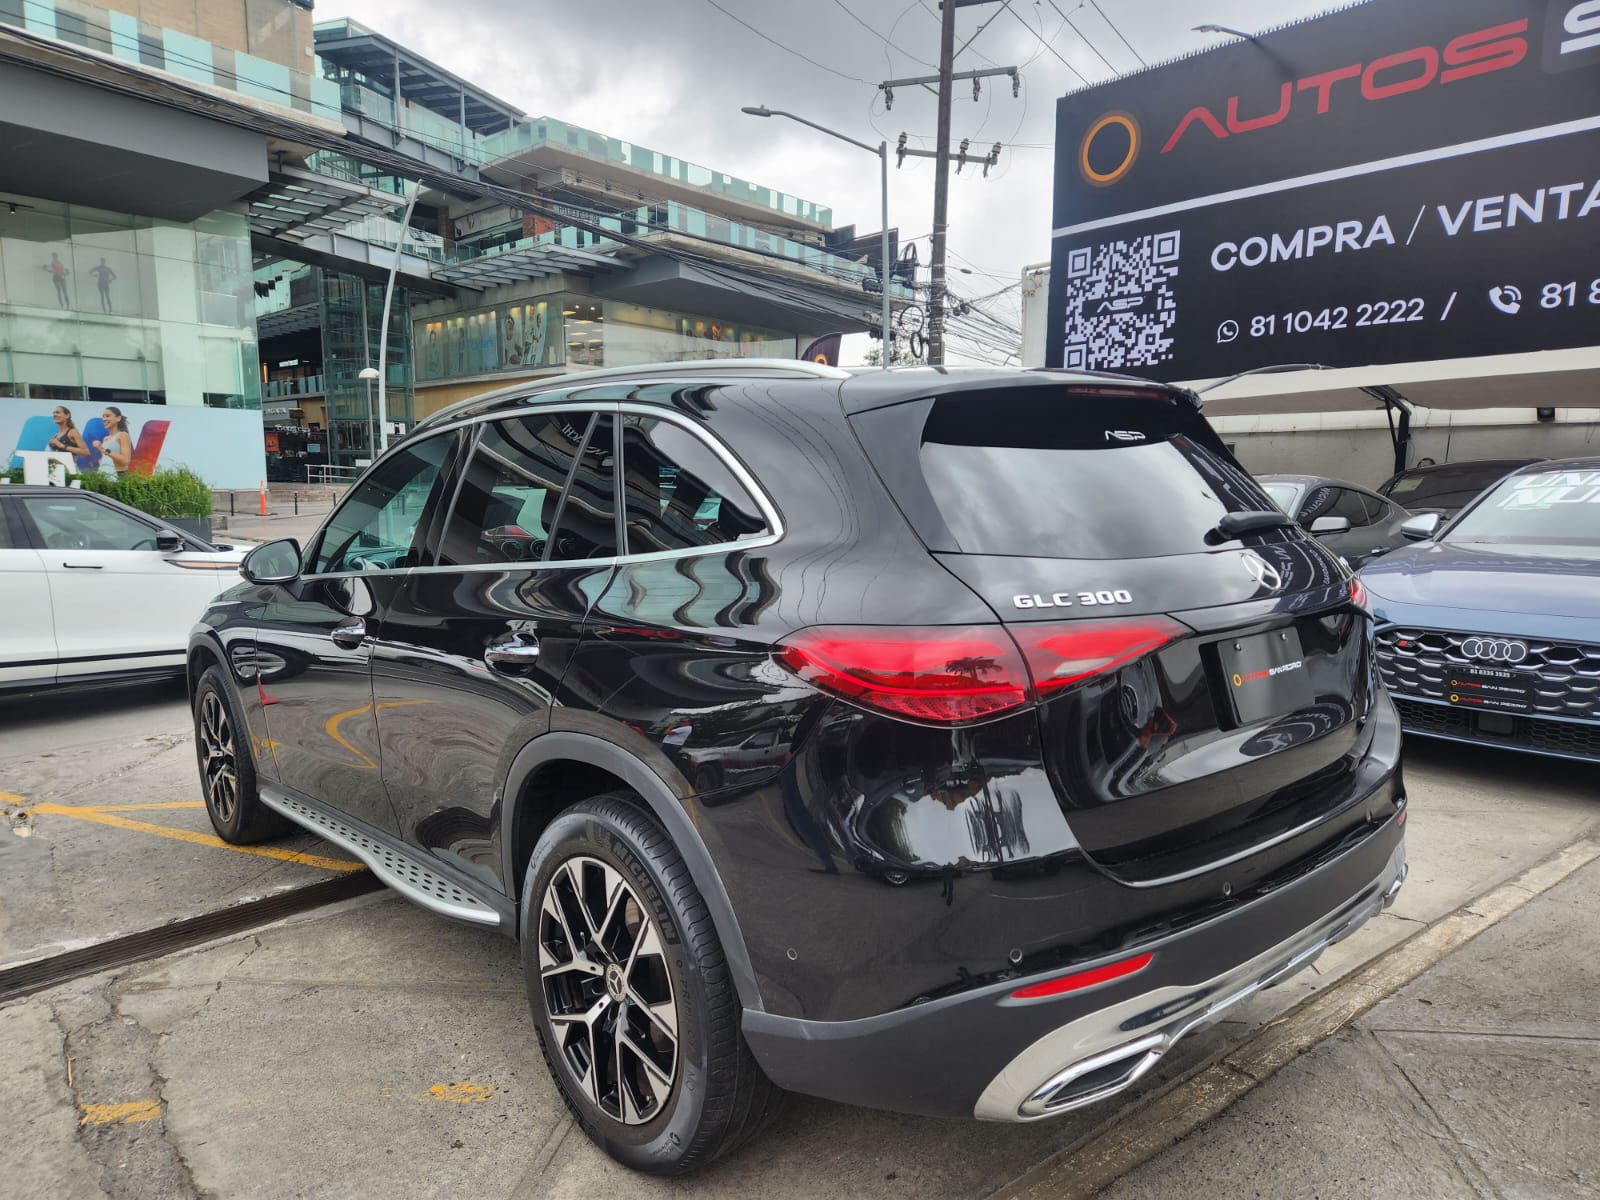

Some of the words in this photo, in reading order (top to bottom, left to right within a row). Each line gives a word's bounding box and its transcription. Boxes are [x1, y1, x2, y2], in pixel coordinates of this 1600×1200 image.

[1160, 18, 1528, 153] AUTOS
[1210, 214, 1396, 272] COMPRA
[1436, 179, 1600, 236] VENTA
[1250, 314, 1276, 337] 81
[1282, 306, 1348, 334] 1042
[1355, 297, 1425, 327] 2222
[1540, 281, 1577, 309] 81
[1013, 593, 1073, 609] GLC
[1077, 589, 1133, 606] 300
[610, 840, 678, 940] MICHELIN
